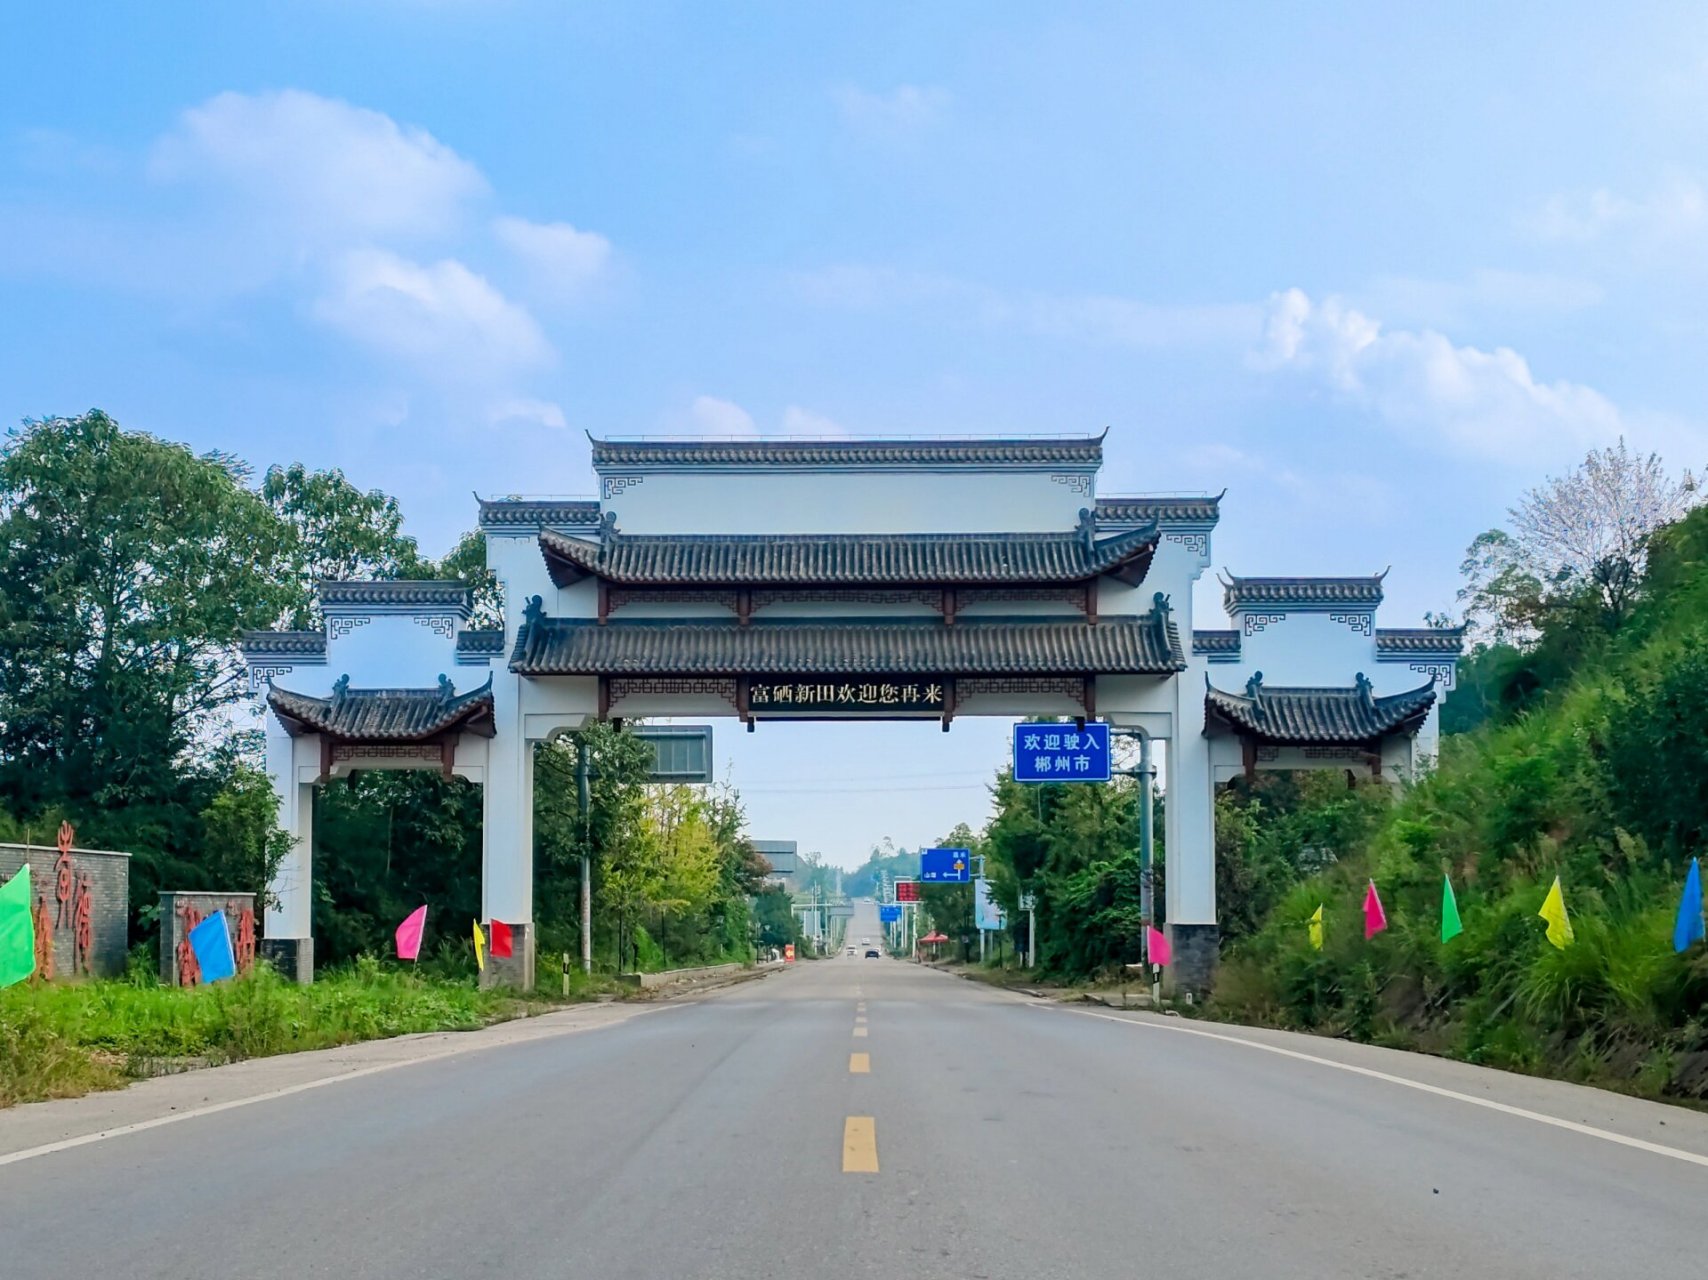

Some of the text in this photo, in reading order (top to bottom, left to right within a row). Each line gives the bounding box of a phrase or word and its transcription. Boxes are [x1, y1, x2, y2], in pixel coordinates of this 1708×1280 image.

[750, 684, 942, 704] 富硒新田欢迎您再来
[1024, 733, 1100, 751] 欢迎驶入
[1034, 754, 1091, 772] 郴州市
